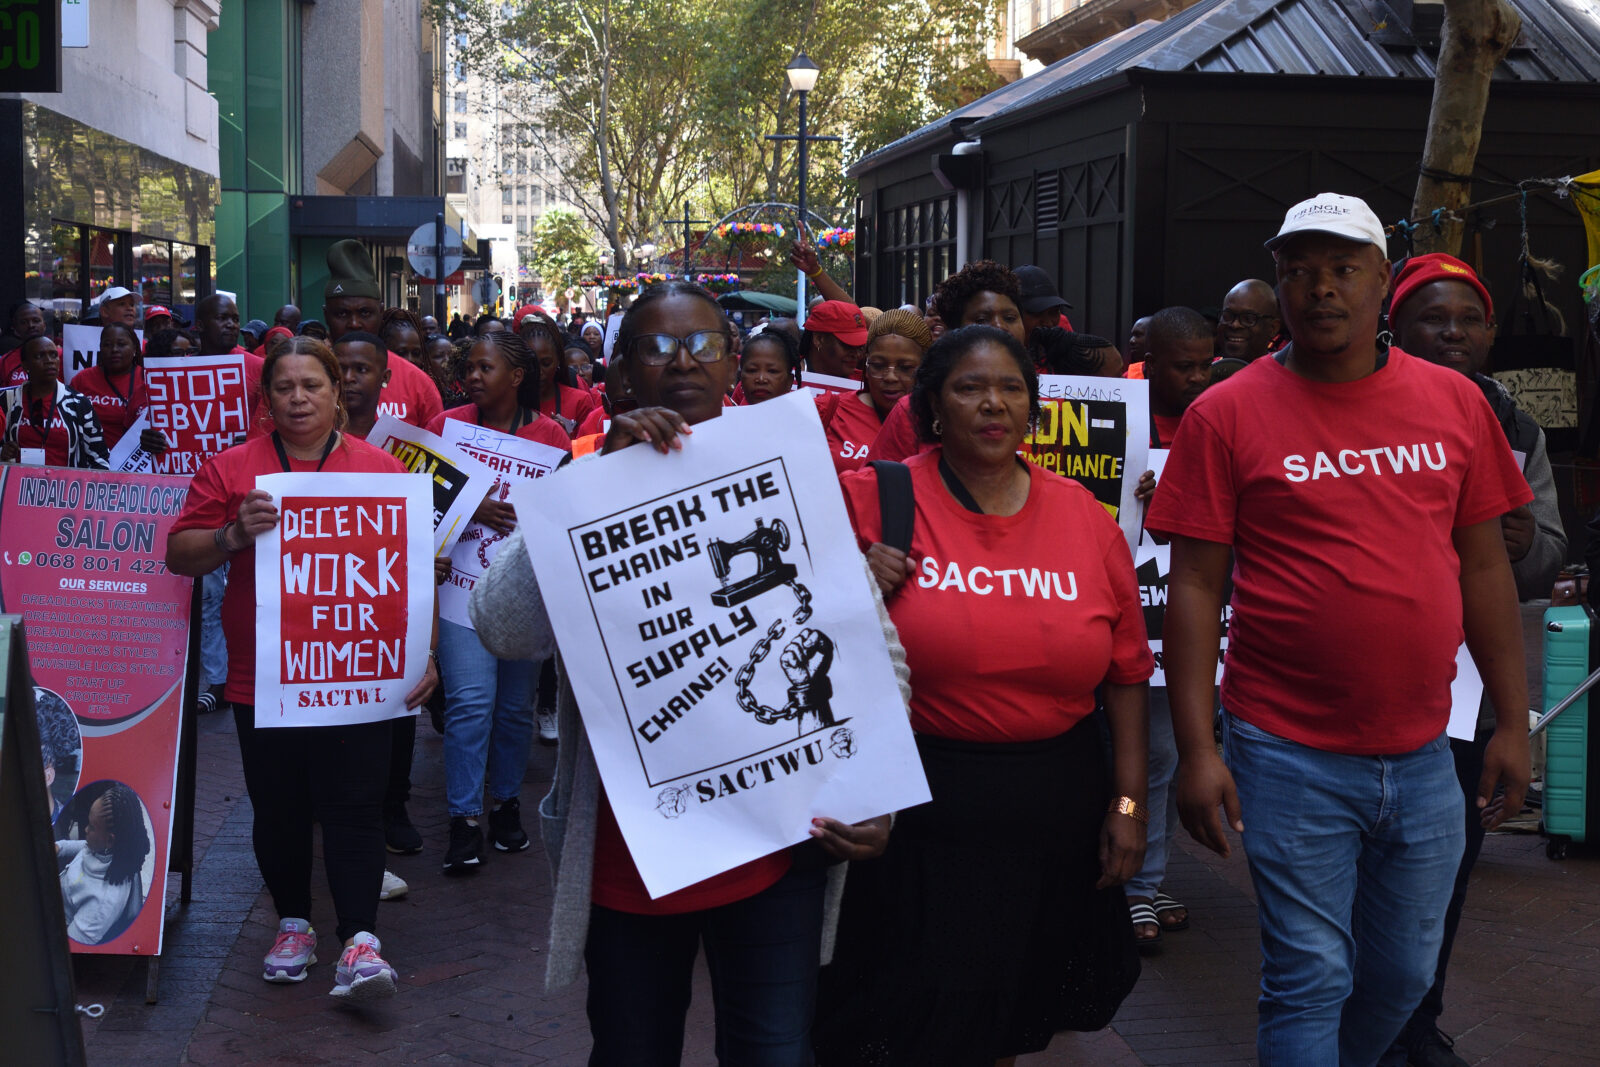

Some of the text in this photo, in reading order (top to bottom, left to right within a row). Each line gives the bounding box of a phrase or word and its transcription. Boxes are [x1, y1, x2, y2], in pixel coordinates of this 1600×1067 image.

[1293, 204, 1351, 219] PRINGLE
[146, 366, 241, 401] STOP
[150, 396, 245, 432] GBVH
[1023, 400, 1115, 446] ON-
[461, 424, 519, 452] JET
[1283, 441, 1448, 483] SACTWU
[18, 477, 80, 510] INDALO
[283, 504, 403, 542] DECENT
[580, 471, 780, 561] BREAK THE
[55, 516, 156, 554] SALON
[36, 552, 75, 569] 068
[83, 556, 120, 572] 801
[282, 547, 401, 599] WORK
[588, 532, 701, 593] CHAINS
[918, 556, 1079, 602] SACTWU
[59, 577, 148, 593] OUR SERVICES
[641, 581, 673, 609] IN
[22, 594, 179, 613] DREADLOCKS TREATMENT
[24, 610, 186, 630] DREADLOCKS EXTENSIONS
[312, 602, 380, 631] FOR
[24, 626, 161, 644] DREADLOCKS REPAIRS
[638, 606, 694, 641] OUR
[27, 641, 159, 659] DREADLOCKS STYLES
[284, 638, 401, 680] WOMEN
[626, 605, 758, 688] SUPPLY
[32, 657, 175, 675] INVISIBLE LOCS STYLES
[66, 675, 125, 689] START UP
[64, 690, 132, 705] CROTCHET
[638, 656, 733, 744] CHAINS!
[695, 739, 824, 804] SACTWU
